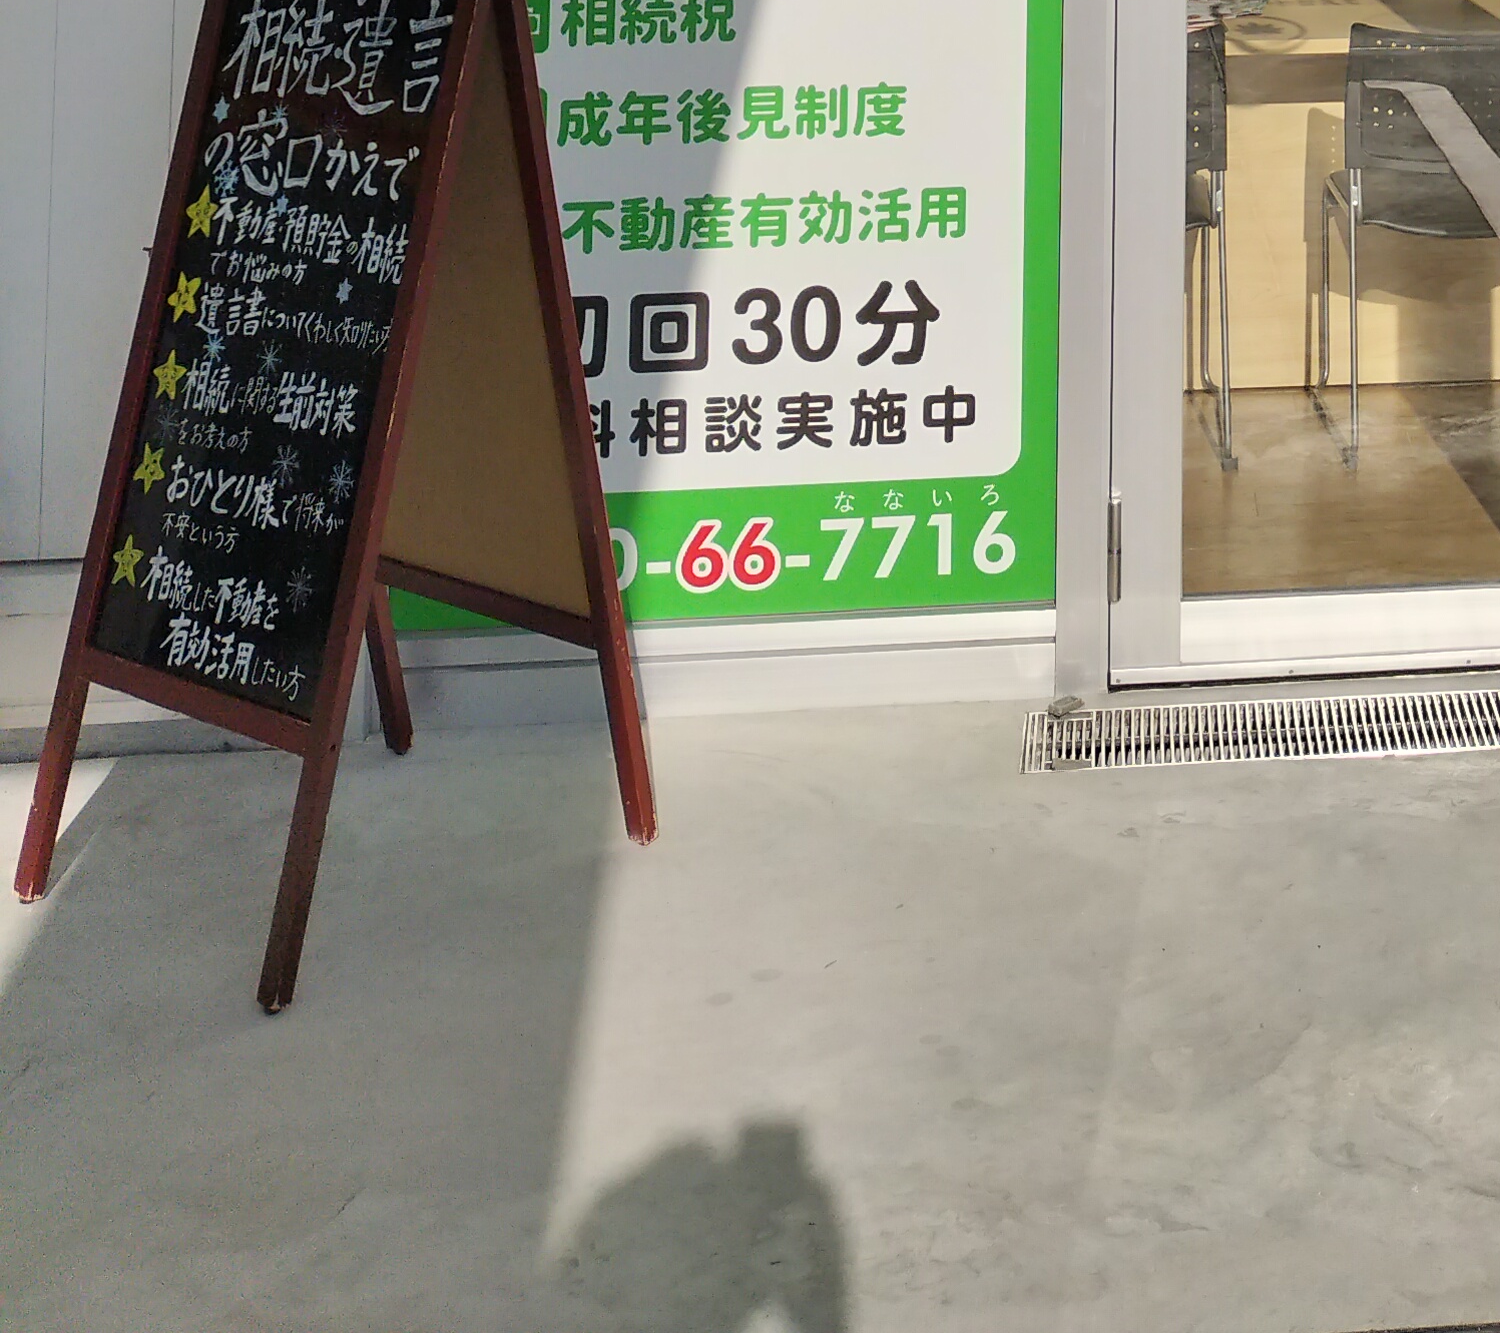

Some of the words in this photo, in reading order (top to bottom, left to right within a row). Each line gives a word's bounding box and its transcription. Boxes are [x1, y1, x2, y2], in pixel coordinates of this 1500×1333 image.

[557, 82, 908, 147] 成年後見制度
[204, 108, 421, 201] の窓口かえで
[562, 186, 967, 254] 不動産有効活用
[210, 251, 309, 285] でお悩みの方
[181, 358, 359, 438] 相続に関する生前対策
[178, 418, 253, 454] をお考えの方
[166, 454, 345, 535] おひとり様で将来が
[162, 512, 240, 553] 不安という方
[140, 545, 280, 632] 相続した不動産を
[159, 612, 307, 702] 有効活用したい方
